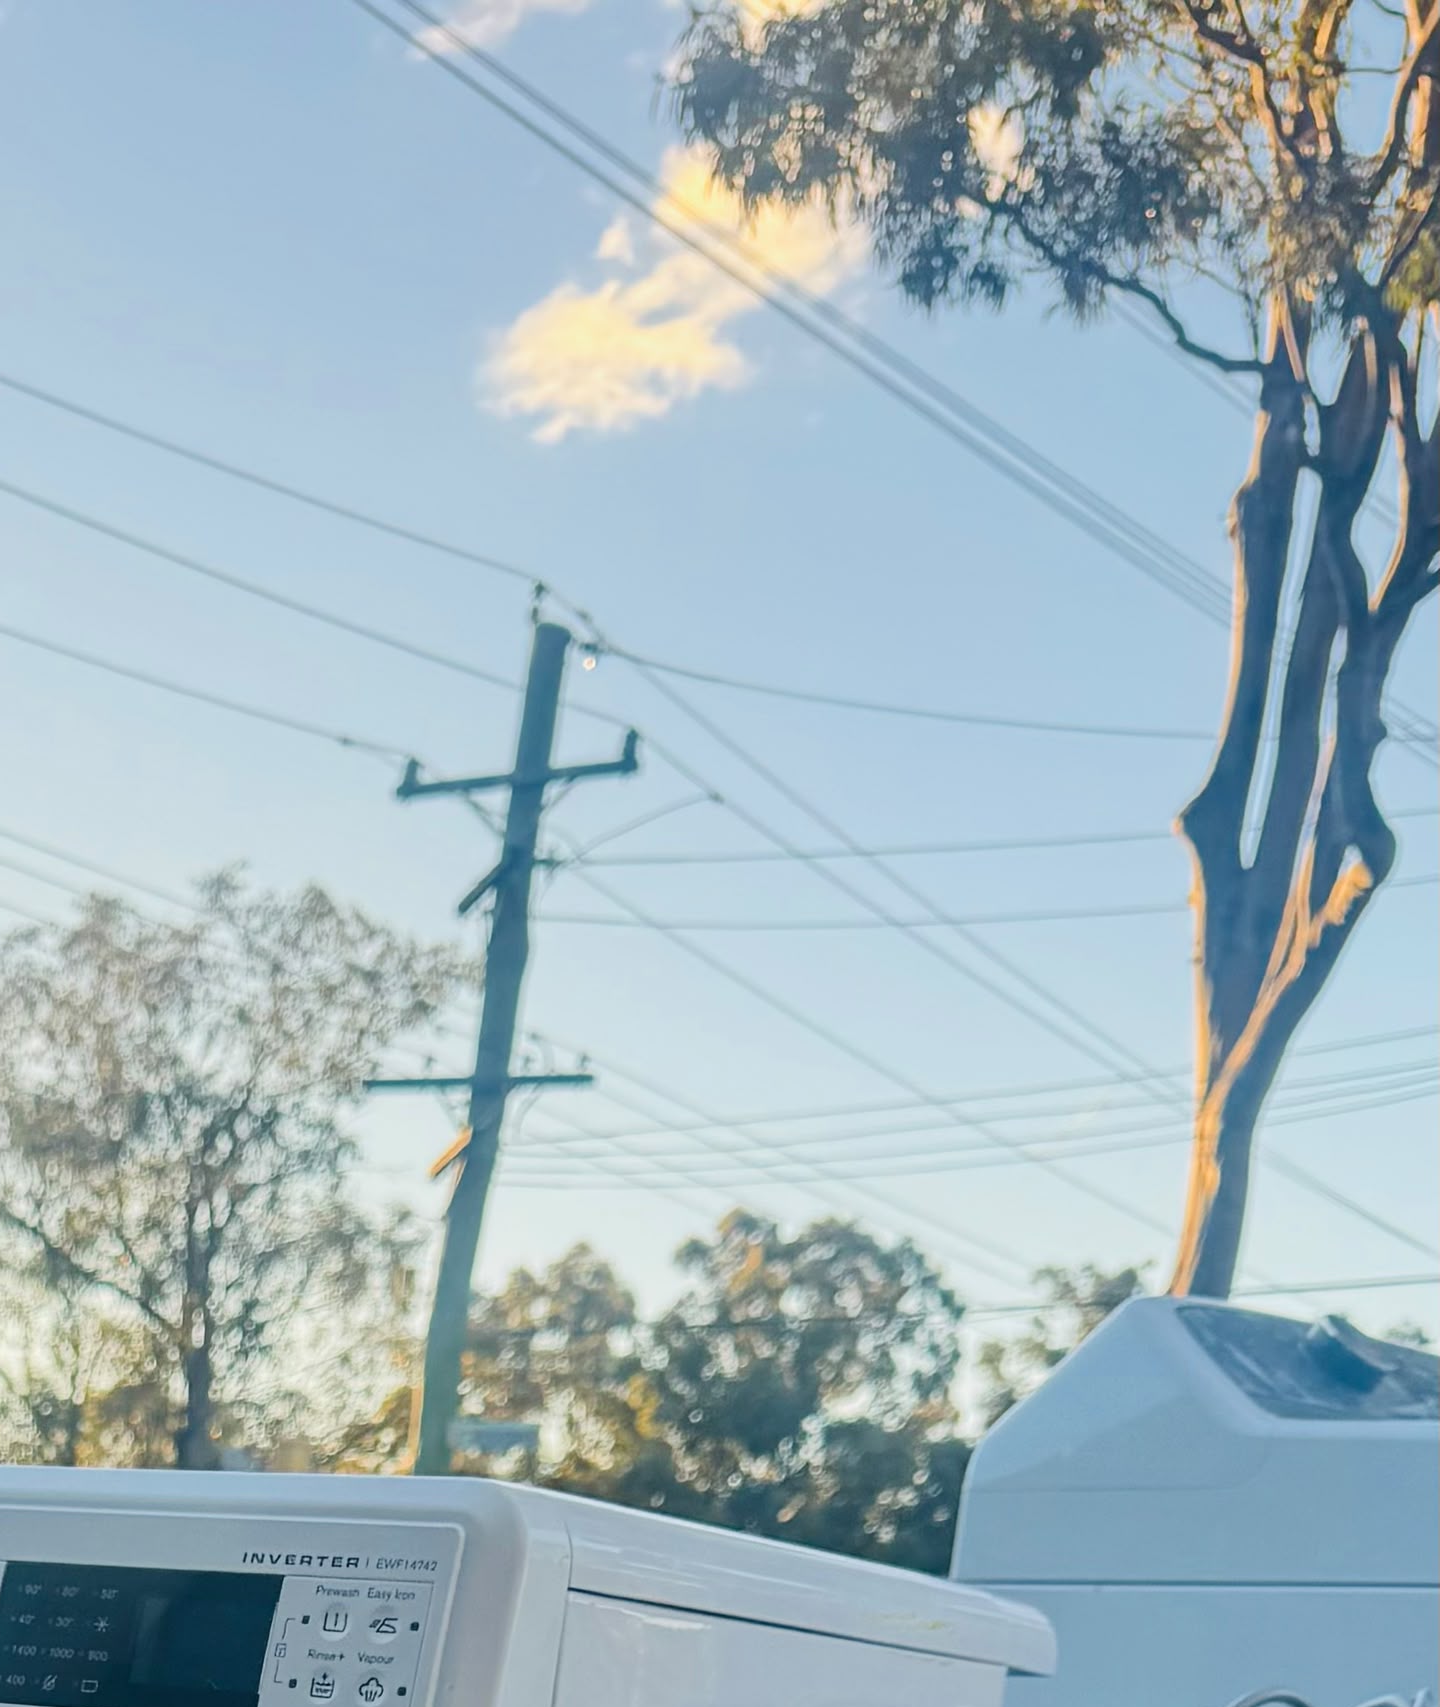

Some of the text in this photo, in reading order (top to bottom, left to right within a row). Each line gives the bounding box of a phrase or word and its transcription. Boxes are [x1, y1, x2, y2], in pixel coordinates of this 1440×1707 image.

[242, 1552, 360, 1569] INVERTER
[315, 1585, 360, 1598] Prewash
[367, 1587, 392, 1601] Easy
[357, 1652, 395, 1666] Vapour
